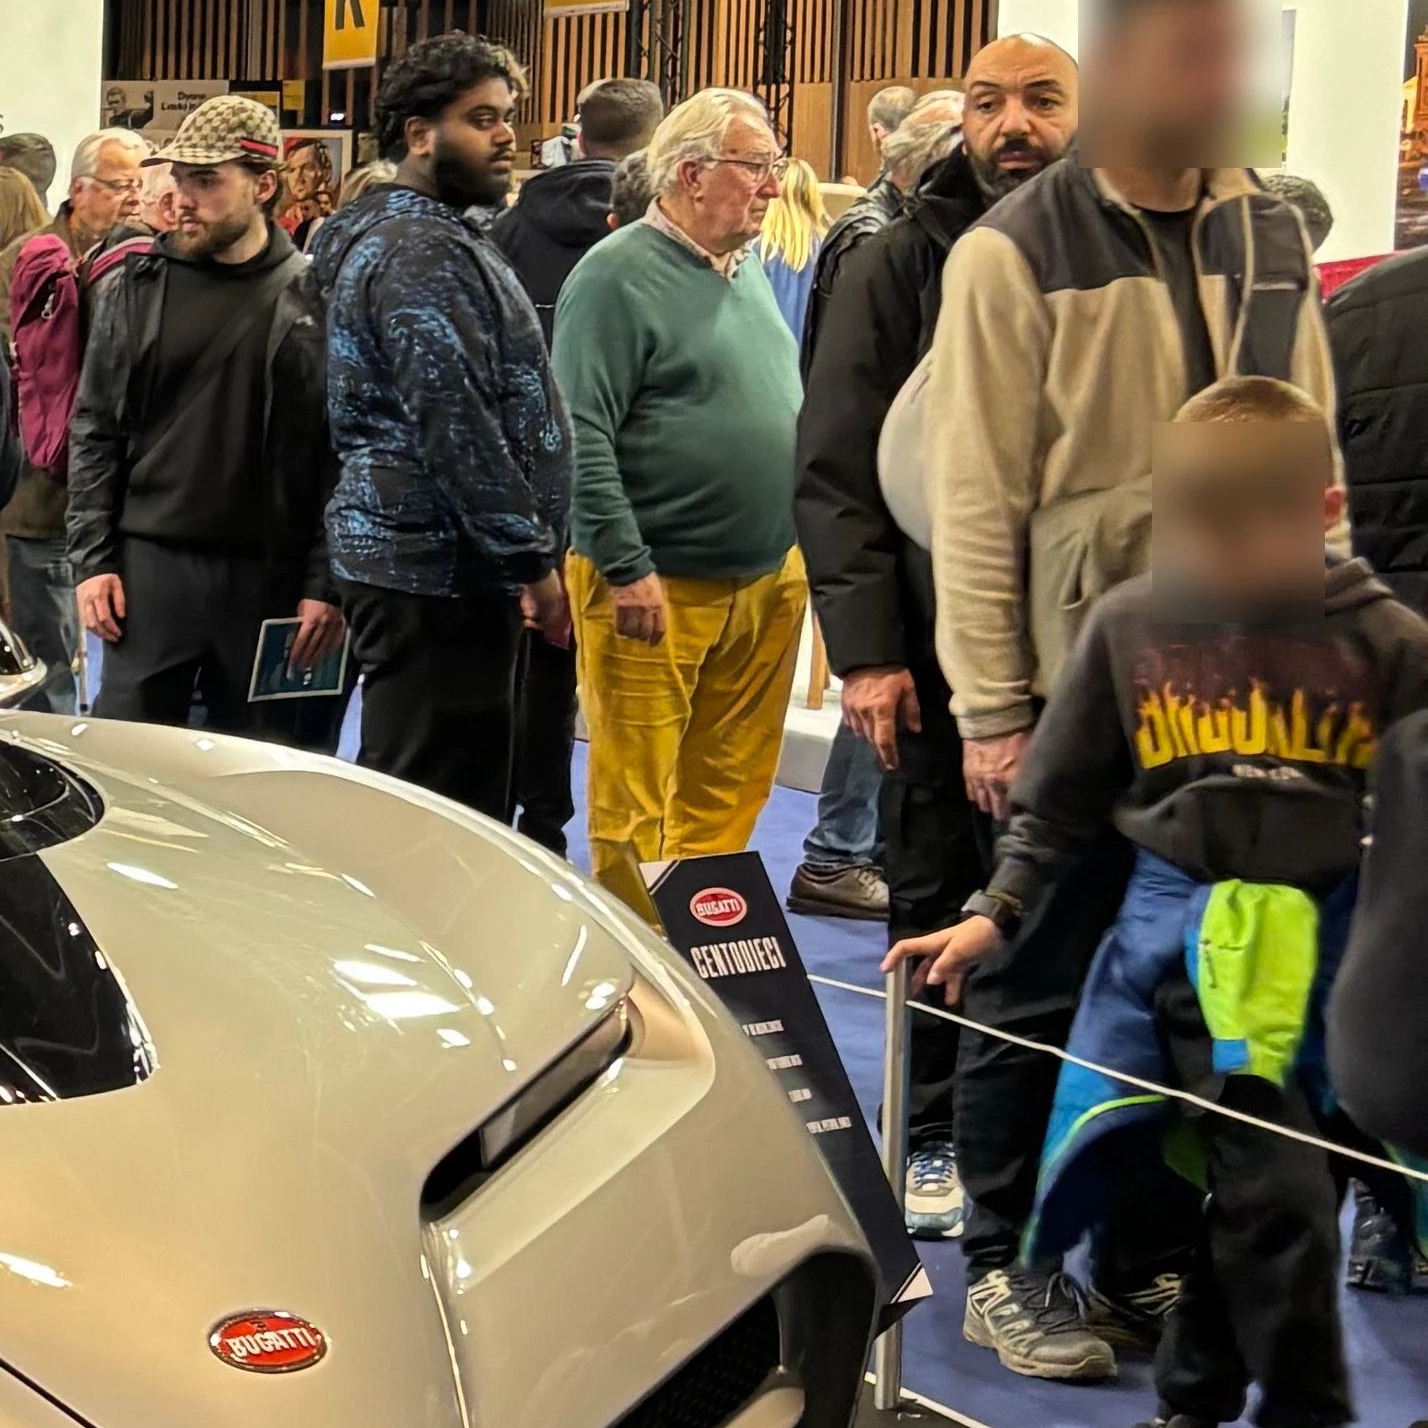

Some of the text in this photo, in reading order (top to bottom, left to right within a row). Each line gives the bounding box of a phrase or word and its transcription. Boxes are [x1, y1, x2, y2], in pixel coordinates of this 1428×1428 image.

[695, 898, 741, 917] BUGATTI
[690, 936, 787, 979] CENTODIECI
[224, 1327, 317, 1358] BUGATTI
